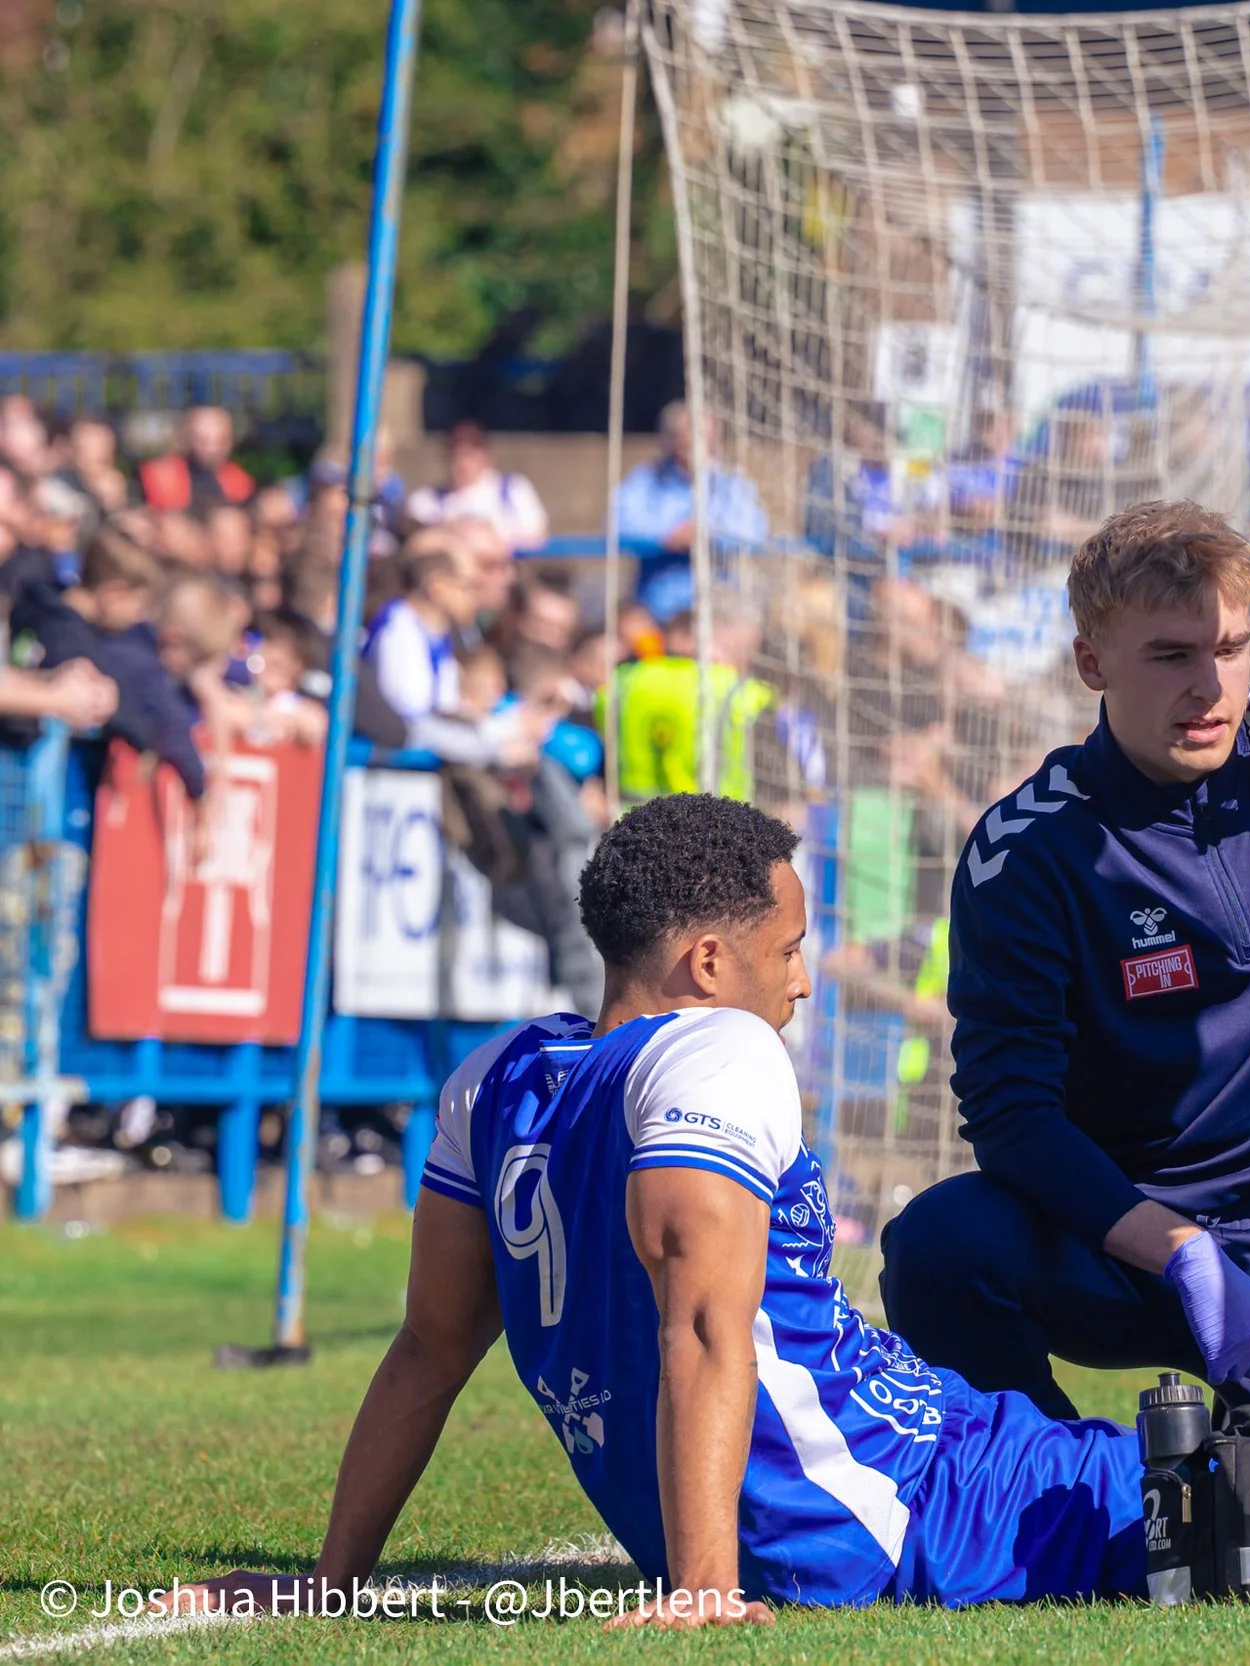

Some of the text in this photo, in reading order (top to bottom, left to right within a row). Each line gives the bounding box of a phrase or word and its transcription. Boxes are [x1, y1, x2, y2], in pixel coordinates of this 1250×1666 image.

[1132, 930, 1176, 950] hummel
[1135, 956, 1183, 979] PITCHING
[1160, 973, 1173, 989] IN
[684, 1111, 722, 1130] GTS
[724, 1128, 755, 1148] EQUIPMENT
[726, 1123, 757, 1144] CLEANING
[494, 1143, 567, 1327] 9
